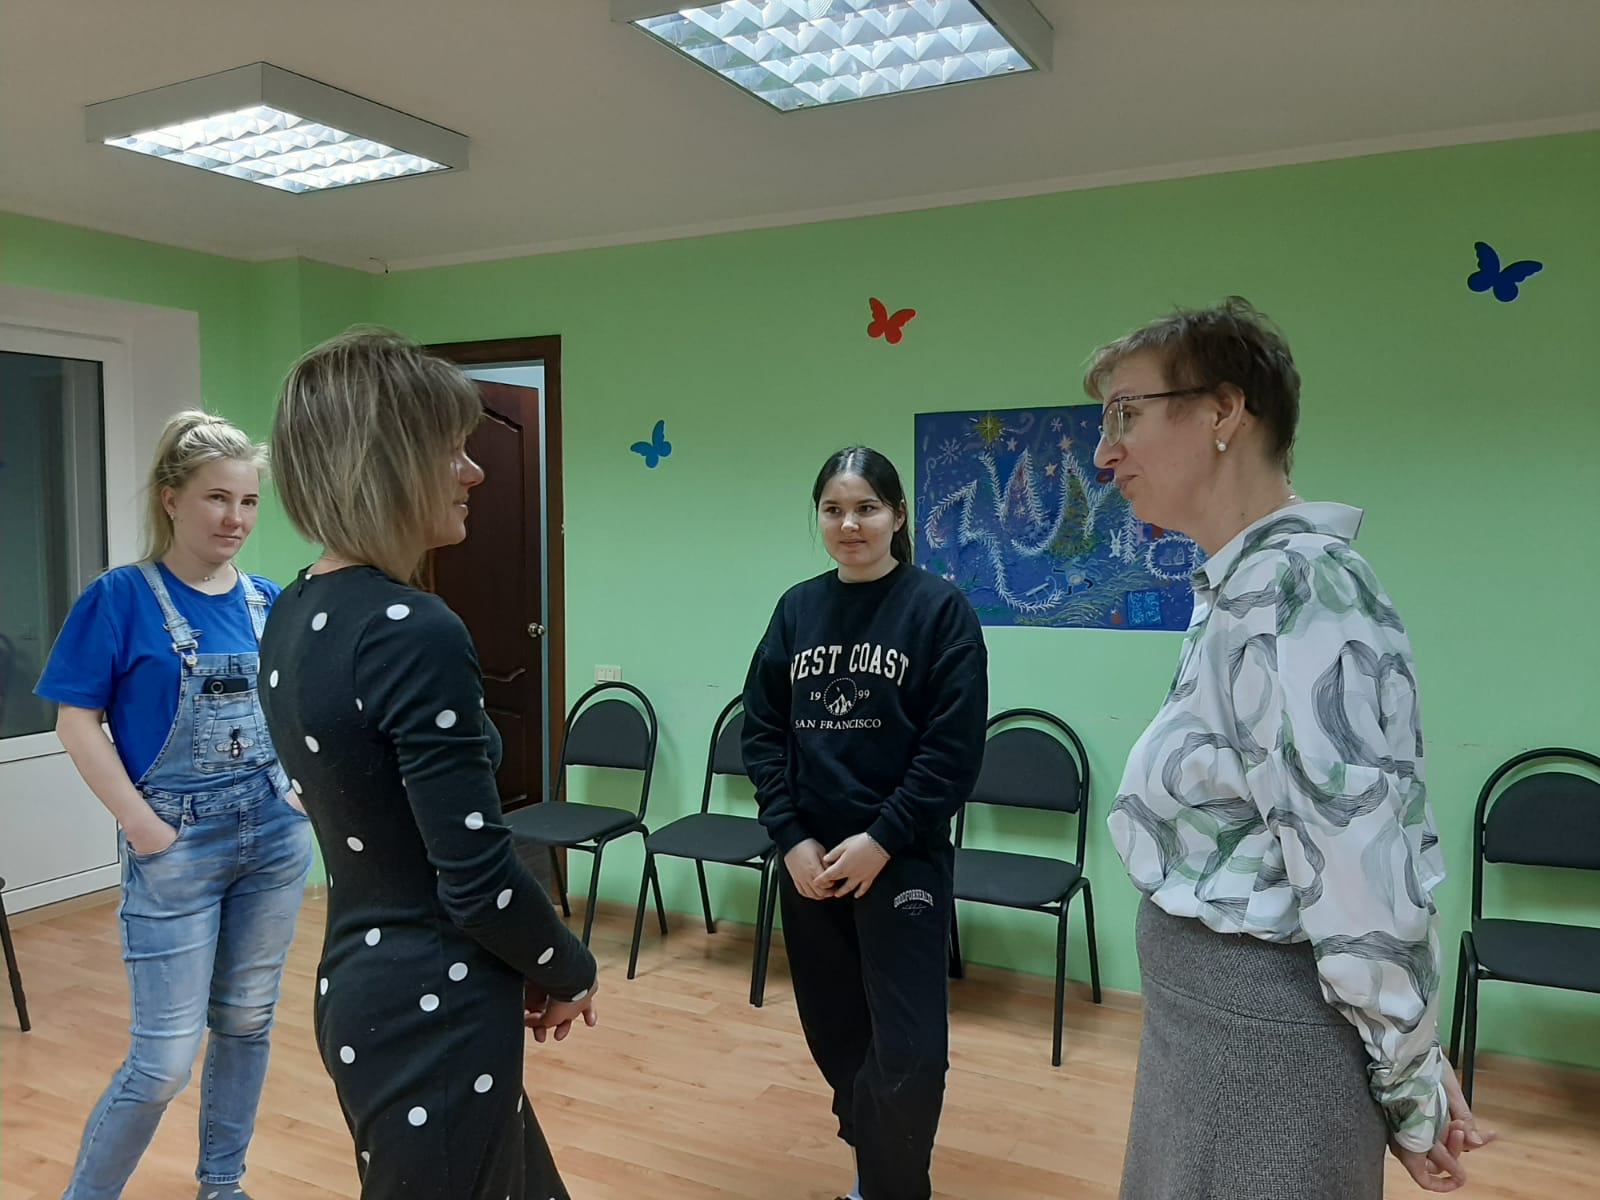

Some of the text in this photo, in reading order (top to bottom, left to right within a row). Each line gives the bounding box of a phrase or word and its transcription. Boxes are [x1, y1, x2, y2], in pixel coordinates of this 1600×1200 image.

[848, 642, 909, 687] COAST
[809, 689, 870, 701] 19 99
[795, 718, 881, 730] SAN FRANCISCO
